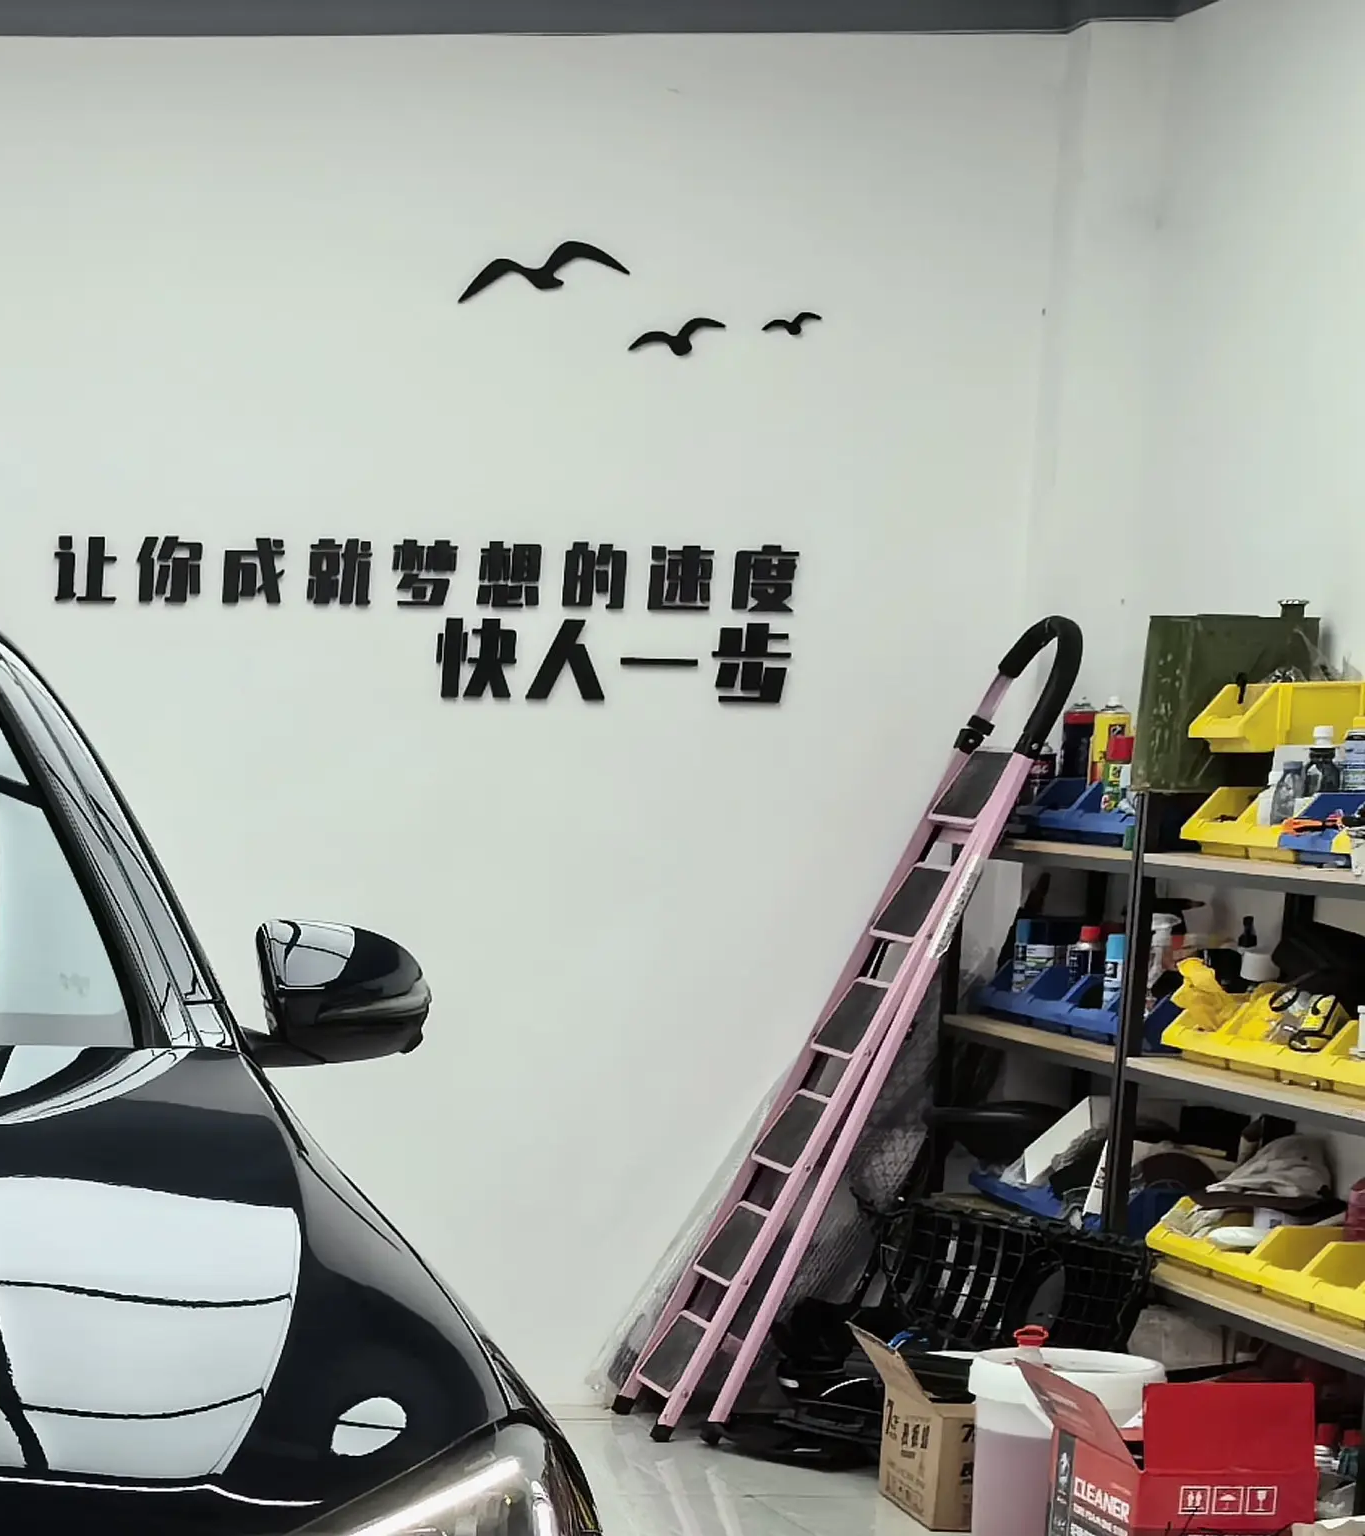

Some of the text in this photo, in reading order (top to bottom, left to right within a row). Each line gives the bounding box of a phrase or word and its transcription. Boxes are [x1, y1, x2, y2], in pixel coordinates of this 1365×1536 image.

[53, 534, 801, 614] 让你成就梦想的速度
[434, 617, 793, 704] 快人一步
[1073, 1476, 1130, 1523] CLEANER
